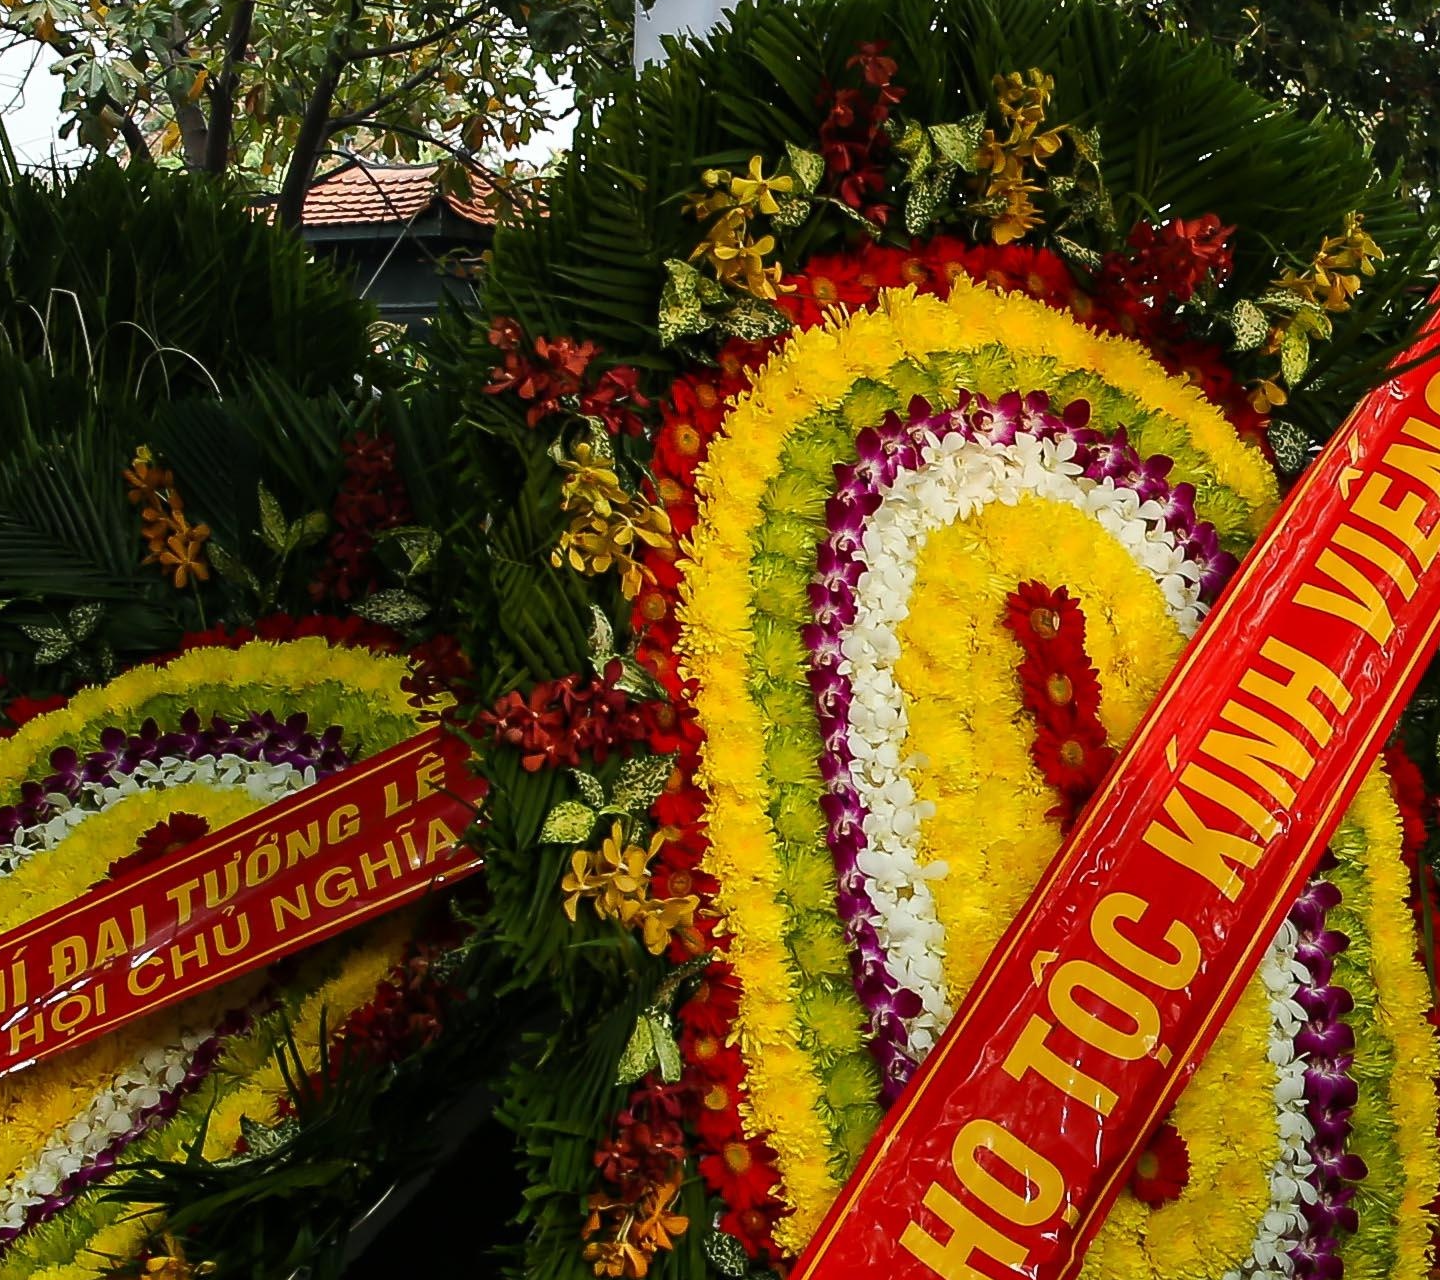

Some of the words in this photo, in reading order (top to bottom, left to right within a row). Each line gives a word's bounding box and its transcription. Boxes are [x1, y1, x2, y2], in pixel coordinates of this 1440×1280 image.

[48, 904, 147, 988] ĐẠI
[166, 803, 361, 926] TƯỚNG
[384, 751, 446, 818] LÊ
[127, 904, 251, 997] CHỦ
[269, 817, 465, 932] NGHĨA
[1000, 891, 1202, 1119] TỘC
[1141, 639, 1355, 905] KÍNH
